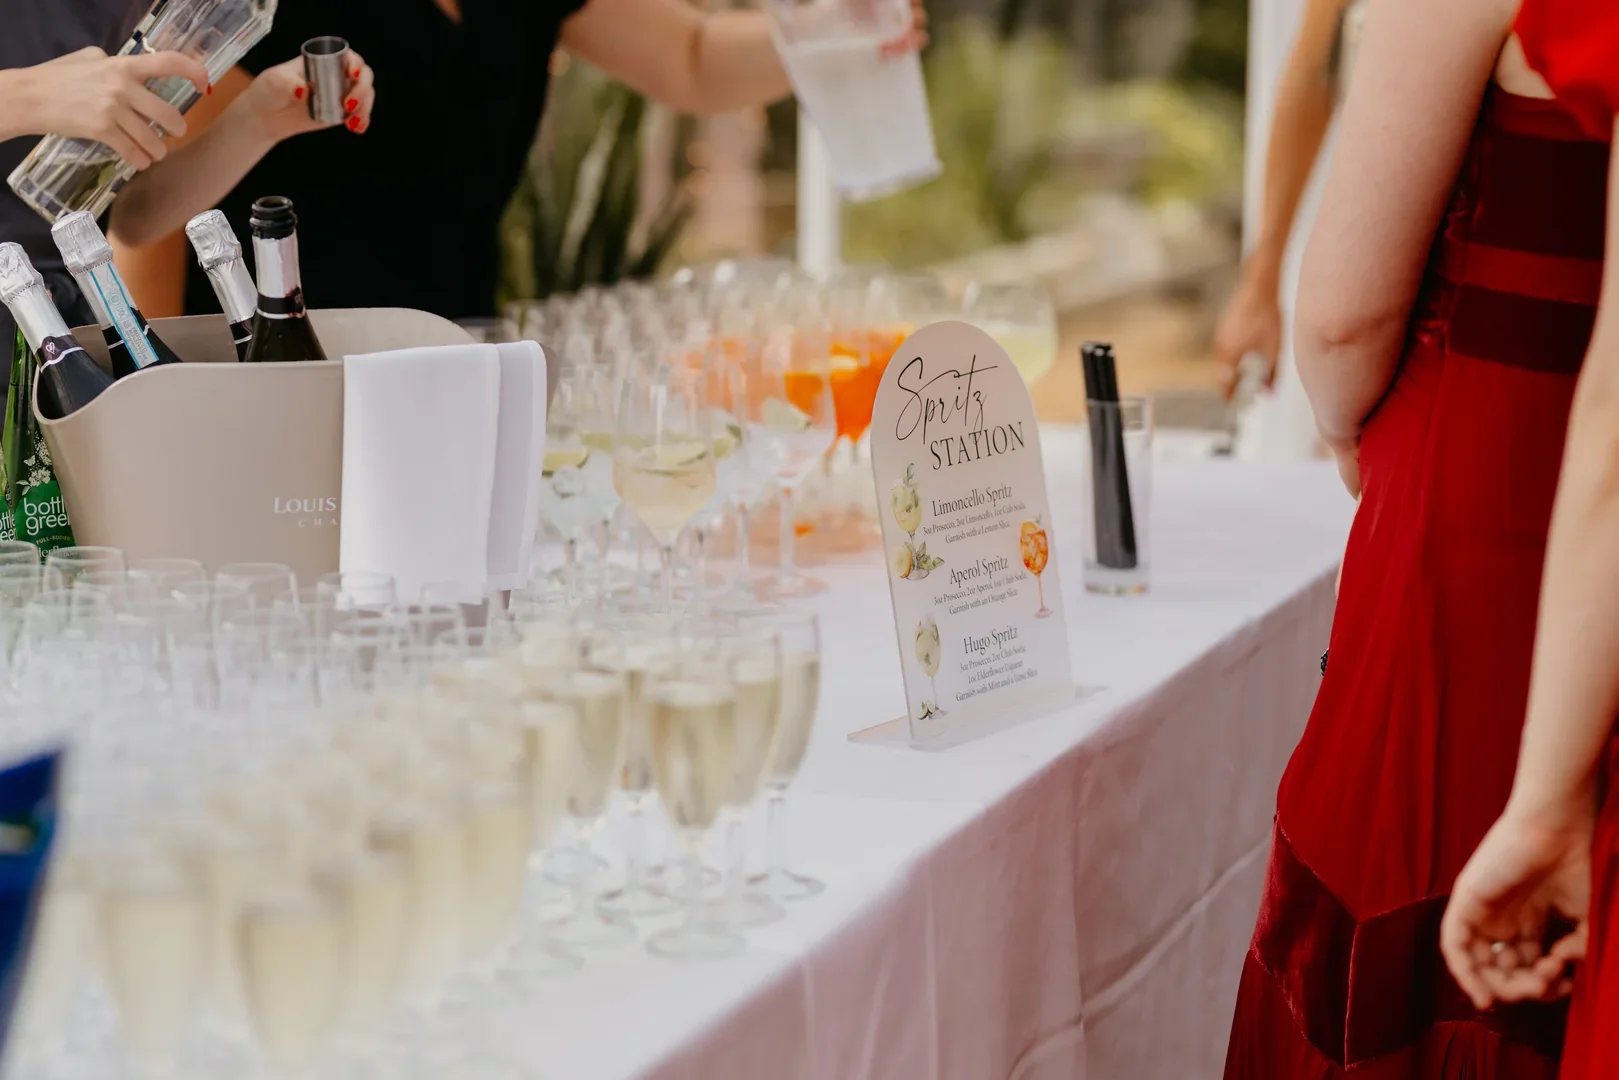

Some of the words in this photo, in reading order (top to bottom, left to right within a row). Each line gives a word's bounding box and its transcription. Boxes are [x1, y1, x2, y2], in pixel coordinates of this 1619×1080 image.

[895, 354, 998, 445] Spritz
[930, 421, 1025, 470] STATION
[23, 495, 65, 516] bottl
[932, 488, 985, 517] Limoncello
[986, 484, 1012, 508] Spritz
[945, 530, 966, 543] Garnish
[966, 526, 977, 538] with
[981, 523, 998, 535] Lemon
[998, 520, 1010, 529] Slice
[950, 559, 980, 588] Aperol
[981, 556, 1008, 579] Spritz
[949, 600, 969, 615] Garnish
[969, 597, 981, 609] with
[981, 598, 988, 606] an
[988, 592, 1006, 603] Orange
[1006, 588, 1018, 598] Slice
[963, 636, 990, 655] Hugo
[991, 625, 1018, 649] Spritz
[1001, 647, 1013, 659] Club
[976, 666, 1004, 681] Elderflower
[955, 688, 976, 701] Garnish
[976, 684, 987, 694] with
[988, 680, 1000, 691] Mint
